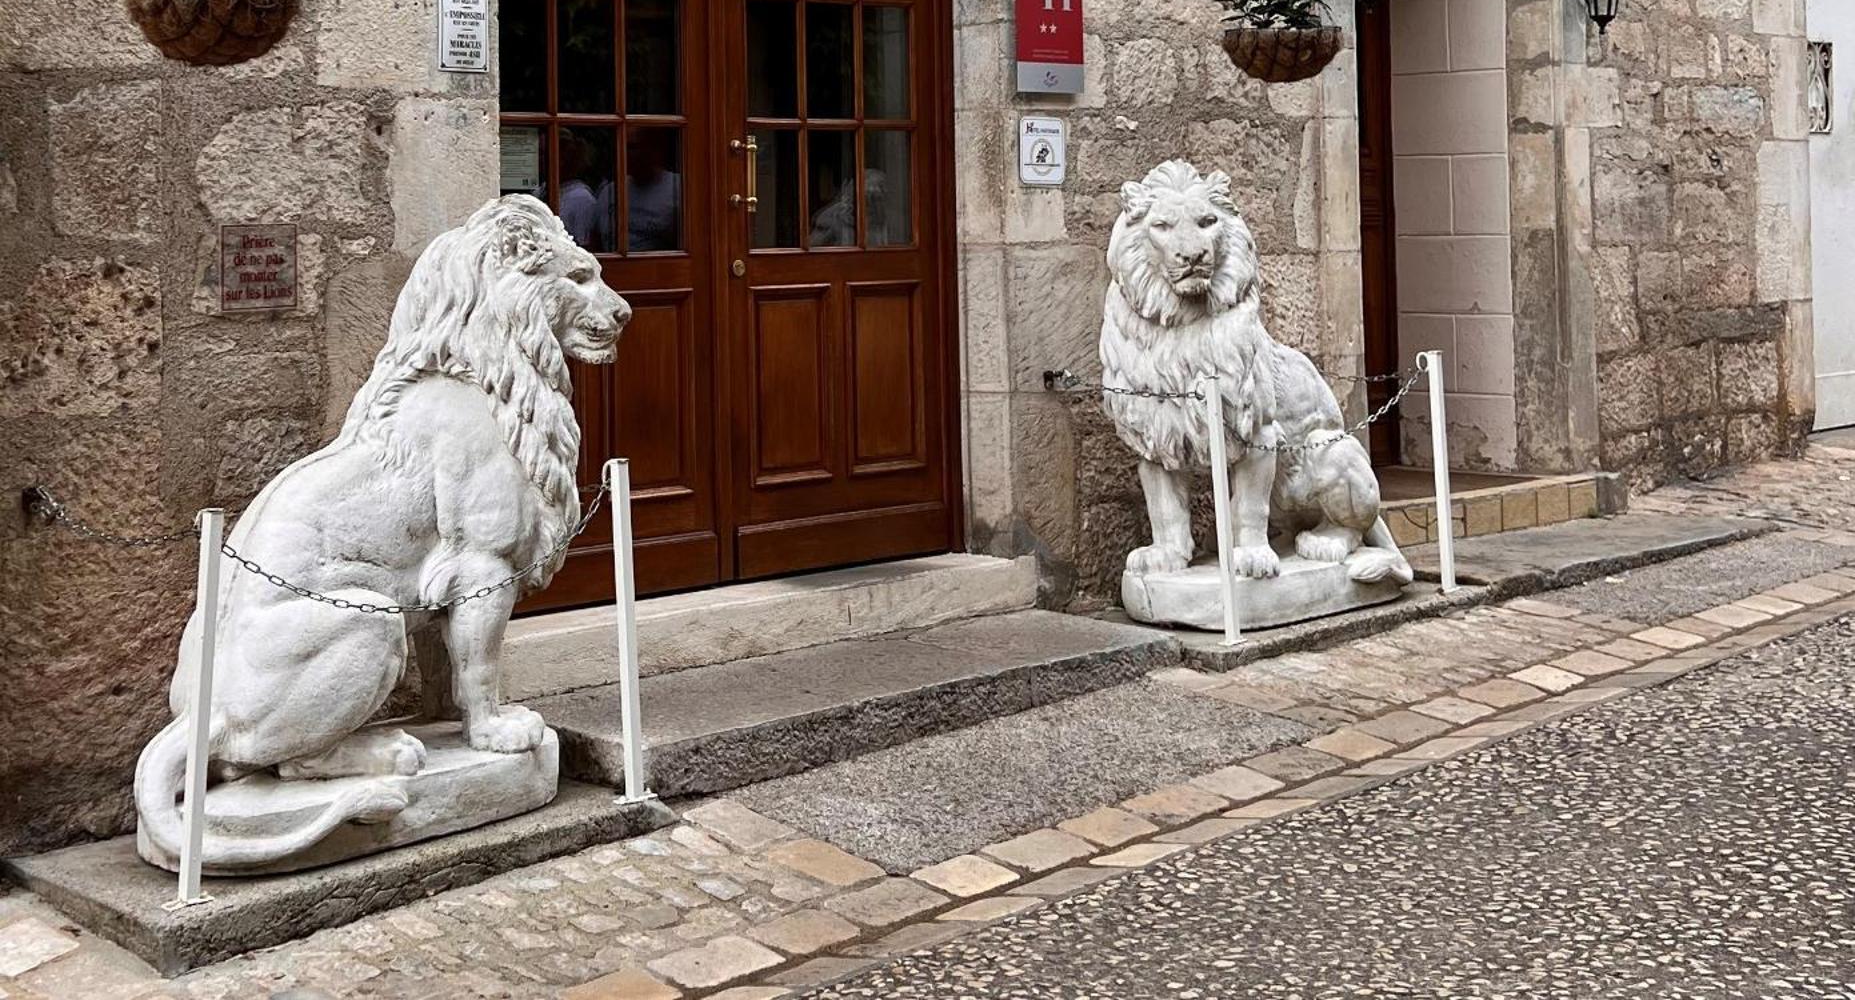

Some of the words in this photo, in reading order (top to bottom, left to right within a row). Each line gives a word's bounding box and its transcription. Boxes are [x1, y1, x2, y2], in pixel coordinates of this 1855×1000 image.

[233, 252, 246, 266] de
[250, 255, 263, 265] ne
[265, 254, 285, 267] pas
[225, 289, 243, 301] sur
[246, 286, 262, 299] les
